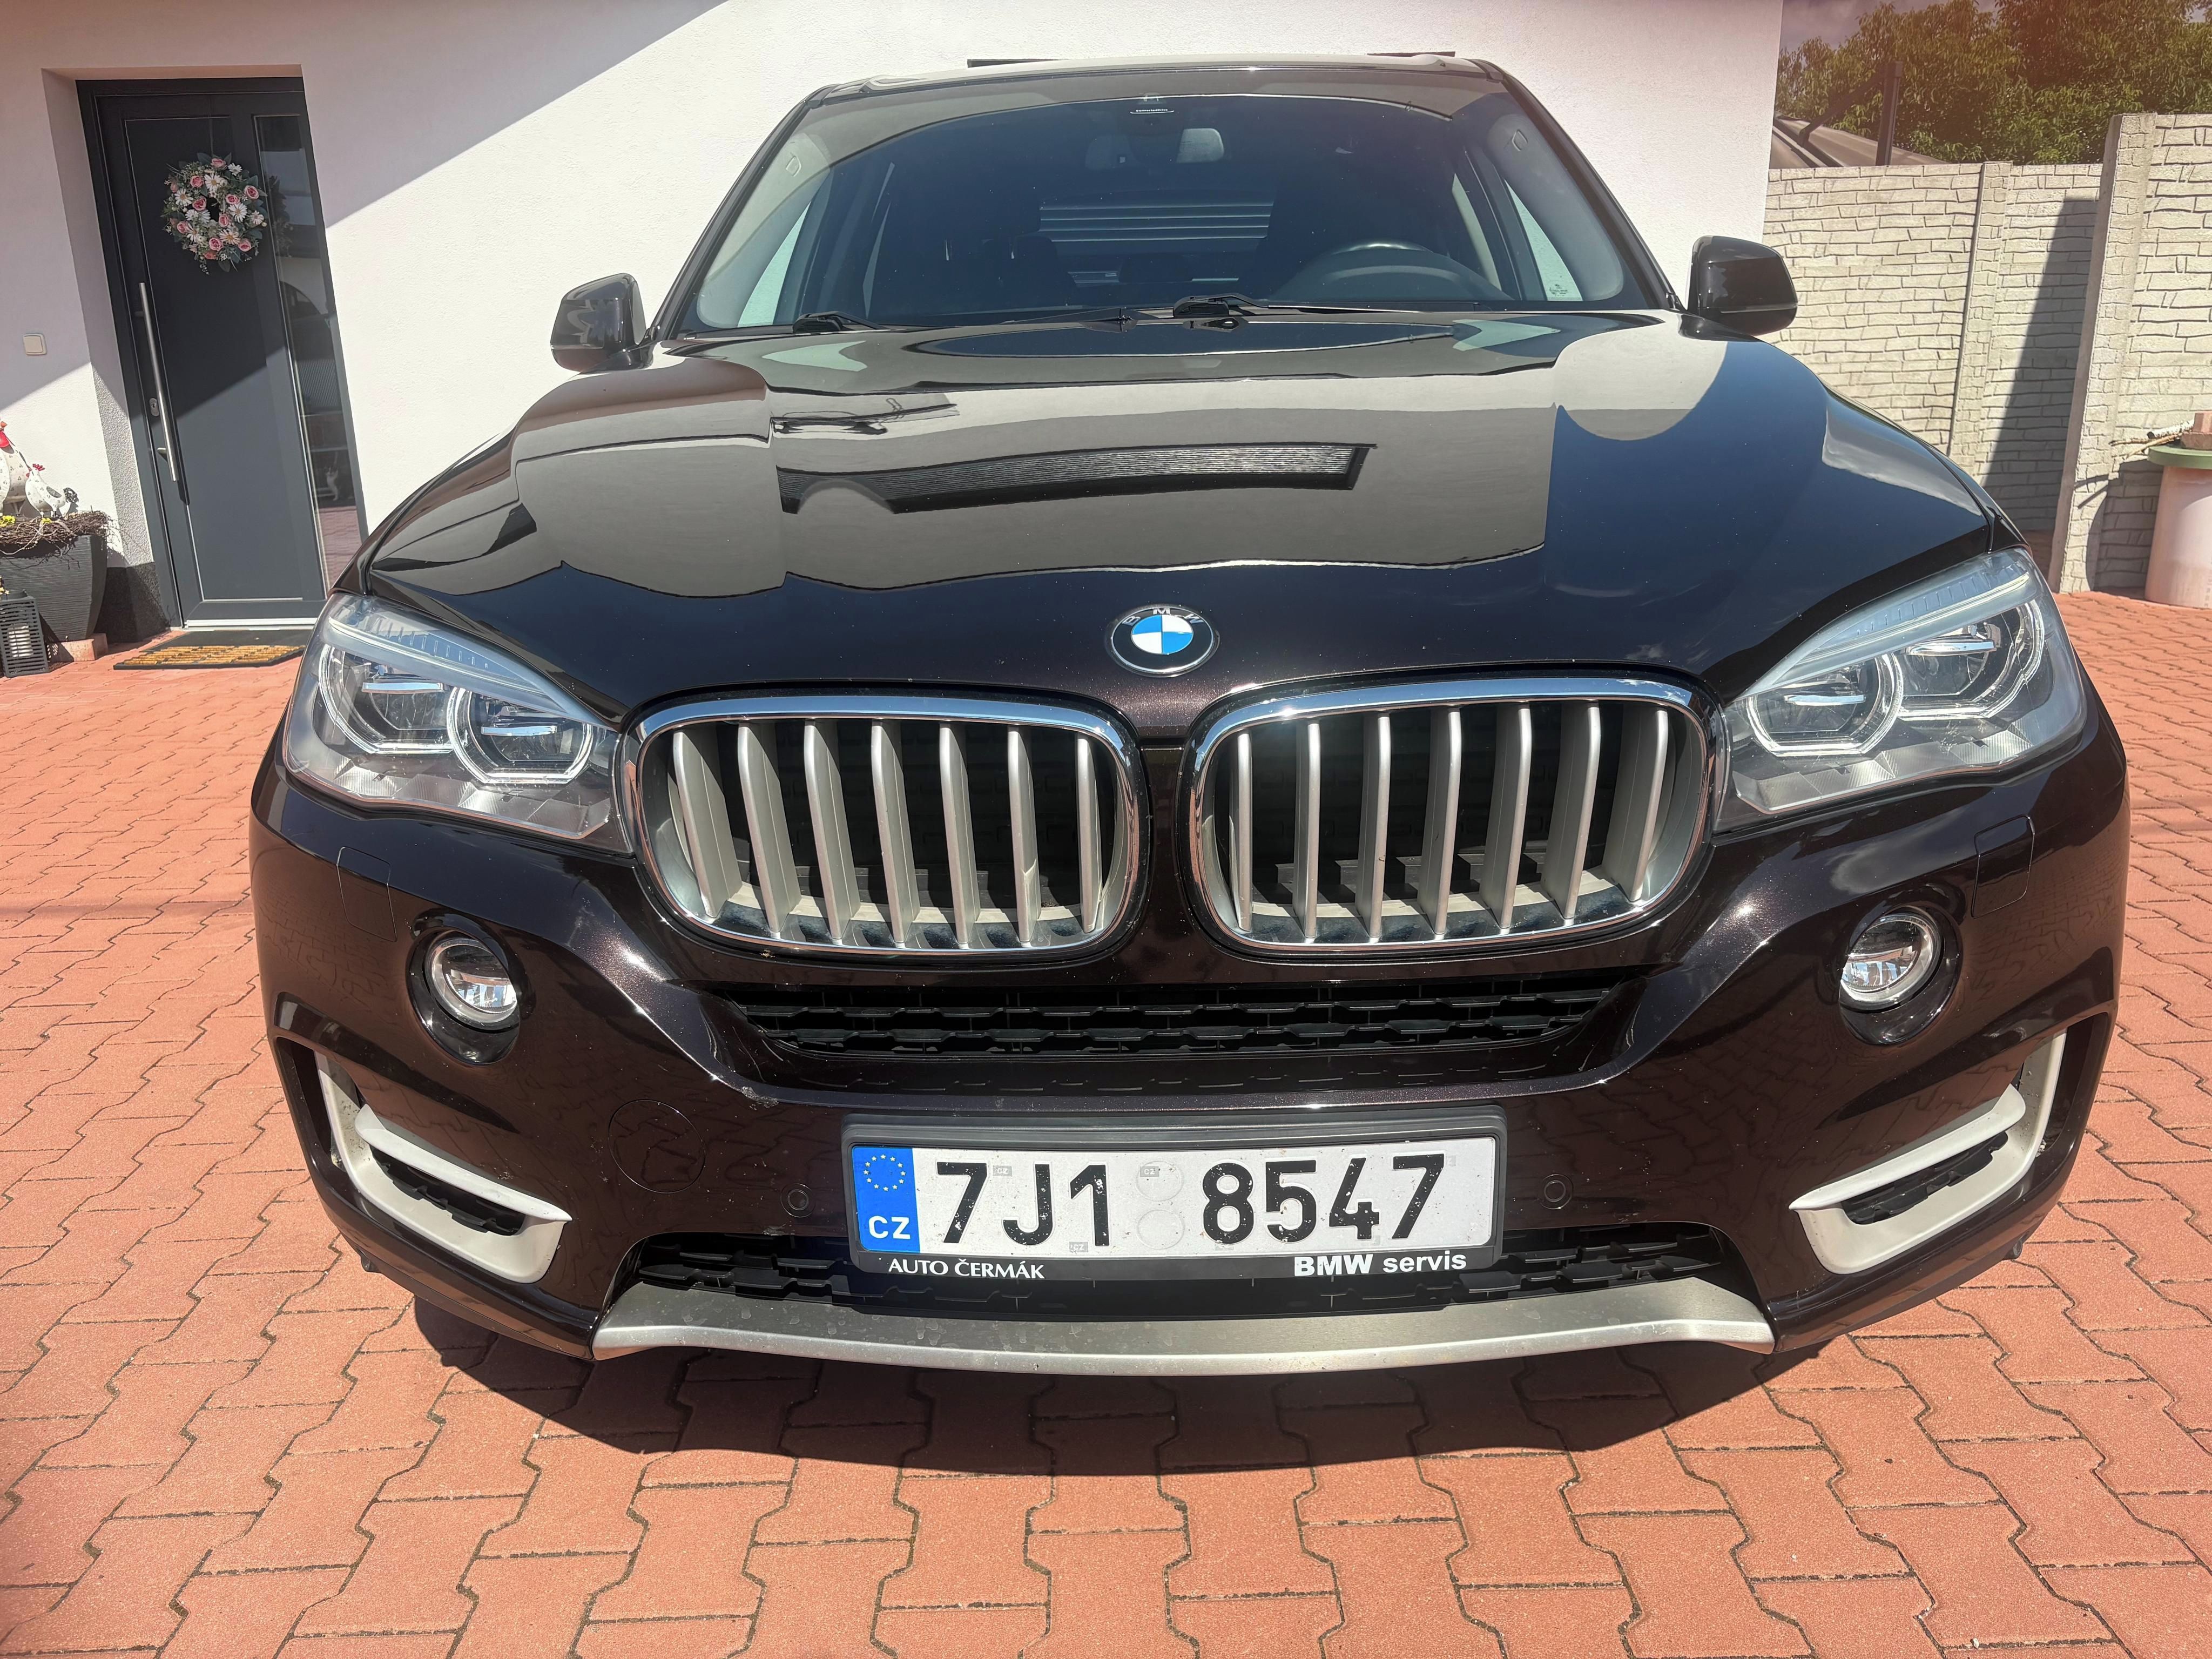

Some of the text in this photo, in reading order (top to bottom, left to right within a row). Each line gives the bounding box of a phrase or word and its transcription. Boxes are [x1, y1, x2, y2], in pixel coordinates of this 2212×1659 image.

[1122, 608, 1204, 626] BMW
[936, 1153, 1445, 1246] 7J1 8547
[868, 1215, 911, 1240] CZ
[888, 1258, 1046, 1279] AUTO ČERMÁK
[1294, 1250, 1467, 1277] BMW servis
